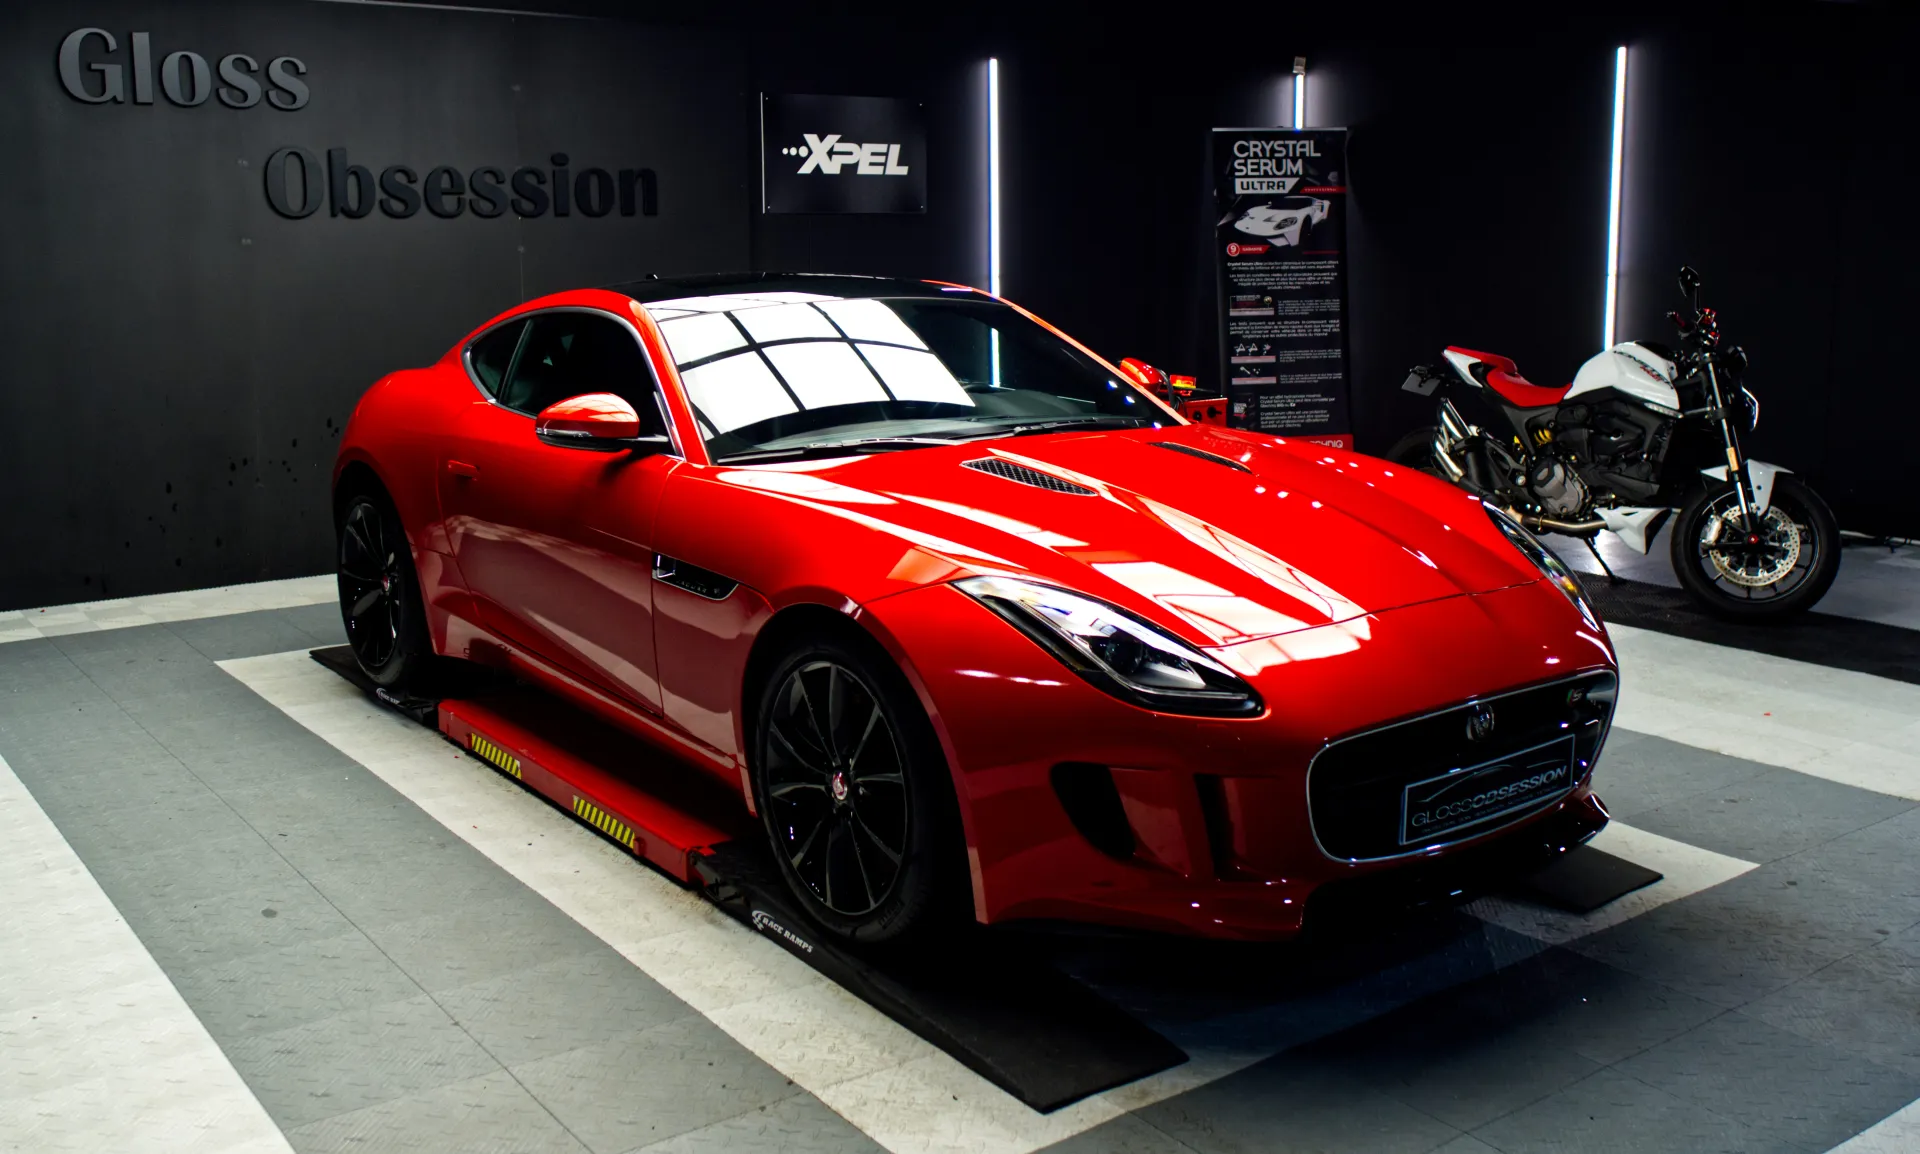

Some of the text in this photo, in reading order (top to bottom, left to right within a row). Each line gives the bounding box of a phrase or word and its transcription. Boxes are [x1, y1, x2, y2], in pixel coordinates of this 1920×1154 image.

[57, 27, 311, 111] Gloss
[797, 133, 909, 175] XPEL
[1233, 140, 1321, 157] CRYSTAL
[262, 146, 660, 220] Obsession
[1233, 159, 1303, 176] SERUM
[1240, 181, 1286, 191] ULTRA
[762, 917, 814, 953] RACE RAMPS
